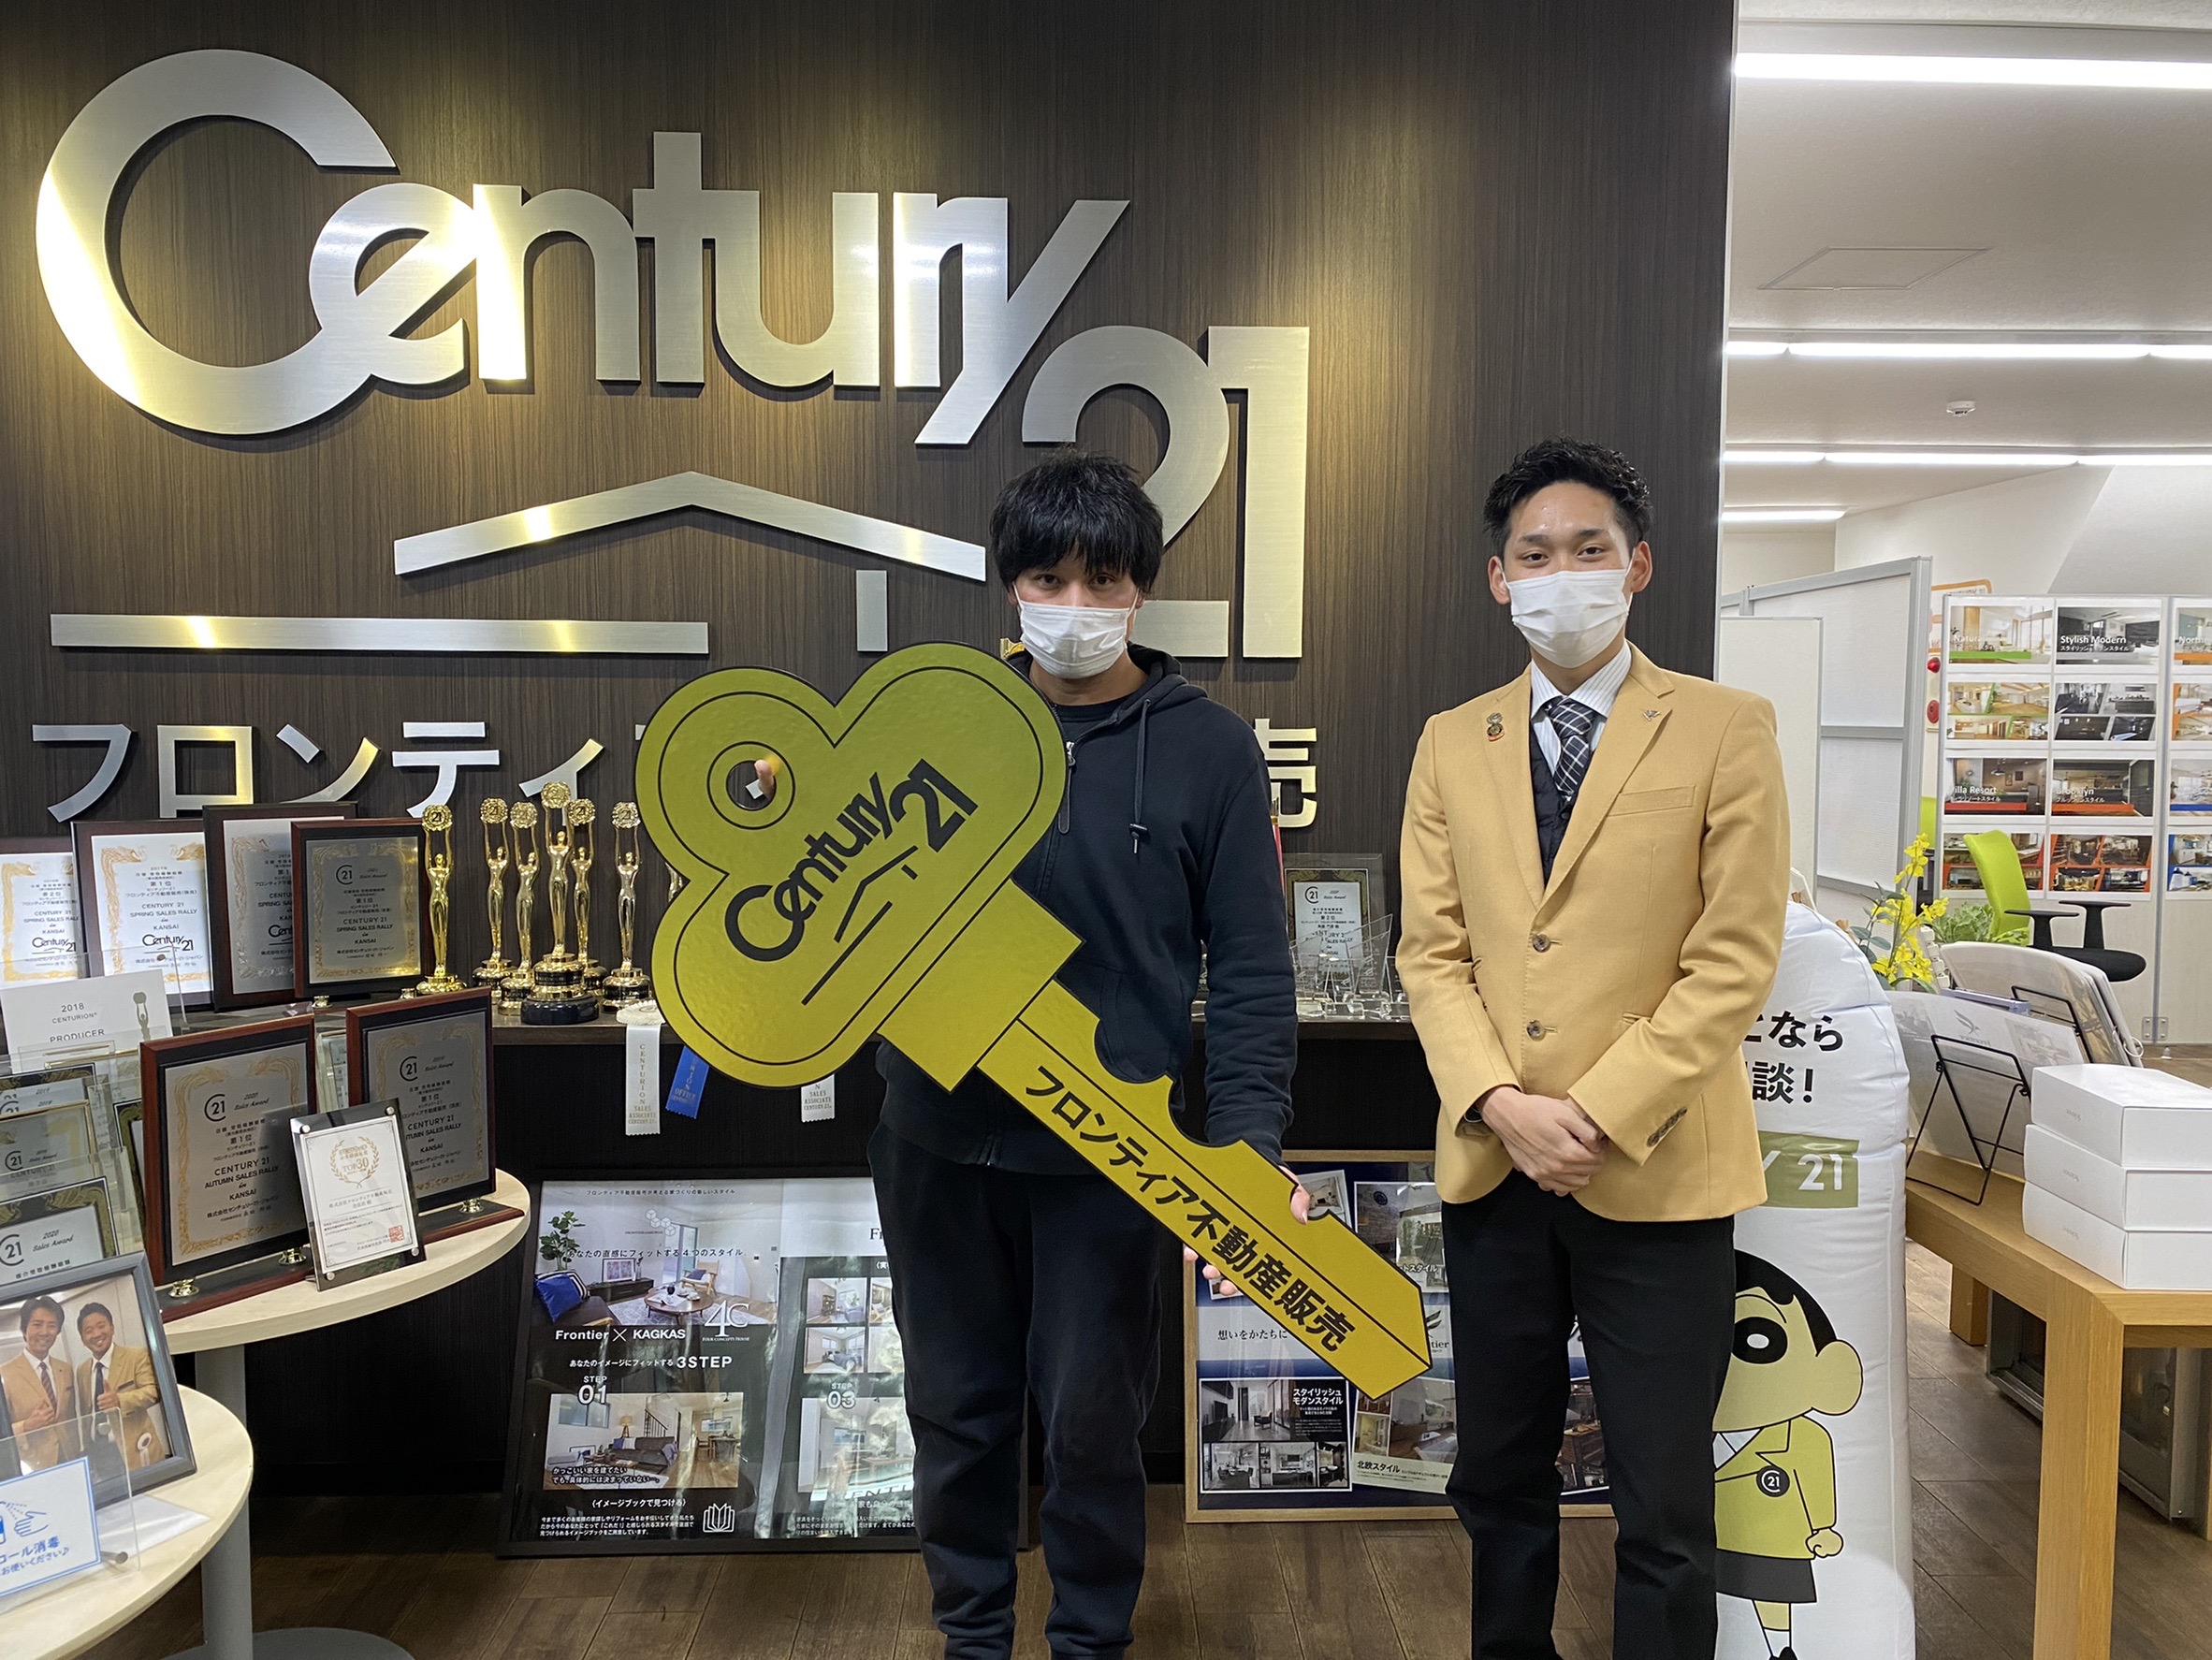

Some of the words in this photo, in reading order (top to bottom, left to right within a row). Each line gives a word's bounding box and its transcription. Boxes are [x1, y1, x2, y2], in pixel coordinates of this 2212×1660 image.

[2060, 635, 2088, 645] Stylish
[32, 722, 646, 827] フロンティ
[1970, 785, 1997, 794] Resort
[432, 811, 443, 823] 21
[724, 771, 893, 962] Century
[889, 758, 979, 853] 21
[32, 937, 69, 948] Century
[141, 934, 184, 947] Century
[61, 1002, 85, 1013] 2018
[50, 1028, 106, 1043] PRODUCER
[1744, 1061, 1814, 1104] 談！
[407, 1118, 445, 1131] CENTURY
[425, 1126, 444, 1136] SALES
[444, 1122, 462, 1130] RALLY
[230, 1133, 253, 1144] 第1位
[420, 1143, 444, 1154] KANSAI
[214, 1158, 259, 1176] CENTURY
[261, 1157, 269, 1166] 21
[1797, 1153, 1843, 1190] 21
[205, 1175, 234, 1189] AUTUMN
[235, 1170, 258, 1182] SALES
[258, 1165, 280, 1176] RALLY
[229, 1188, 257, 1201] KANSAI
[1026, 1065, 1357, 1352] フロンティア不動産販売
[42, 1229, 60, 1240] 2020
[704, 1300, 749, 1337] 4C
[555, 1330, 609, 1341] Frontier
[633, 1329, 687, 1340] KAGKAS
[1217, 1329, 1288, 1341] 想いをかたちに
[569, 1359, 674, 1368] あなたのイメージにフィットする
[677, 1356, 733, 1369] 3STEP
[577, 1384, 608, 1405] 01
[1293, 1388, 1342, 1397] スタイリッシュ
[826, 1390, 856, 1409] 03
[1292, 1396, 1344, 1405] モダンスタイル
[552, 1466, 627, 1475] かっこいい家を建てたい
[1357, 1461, 1401, 1474] 北欧スタイル
